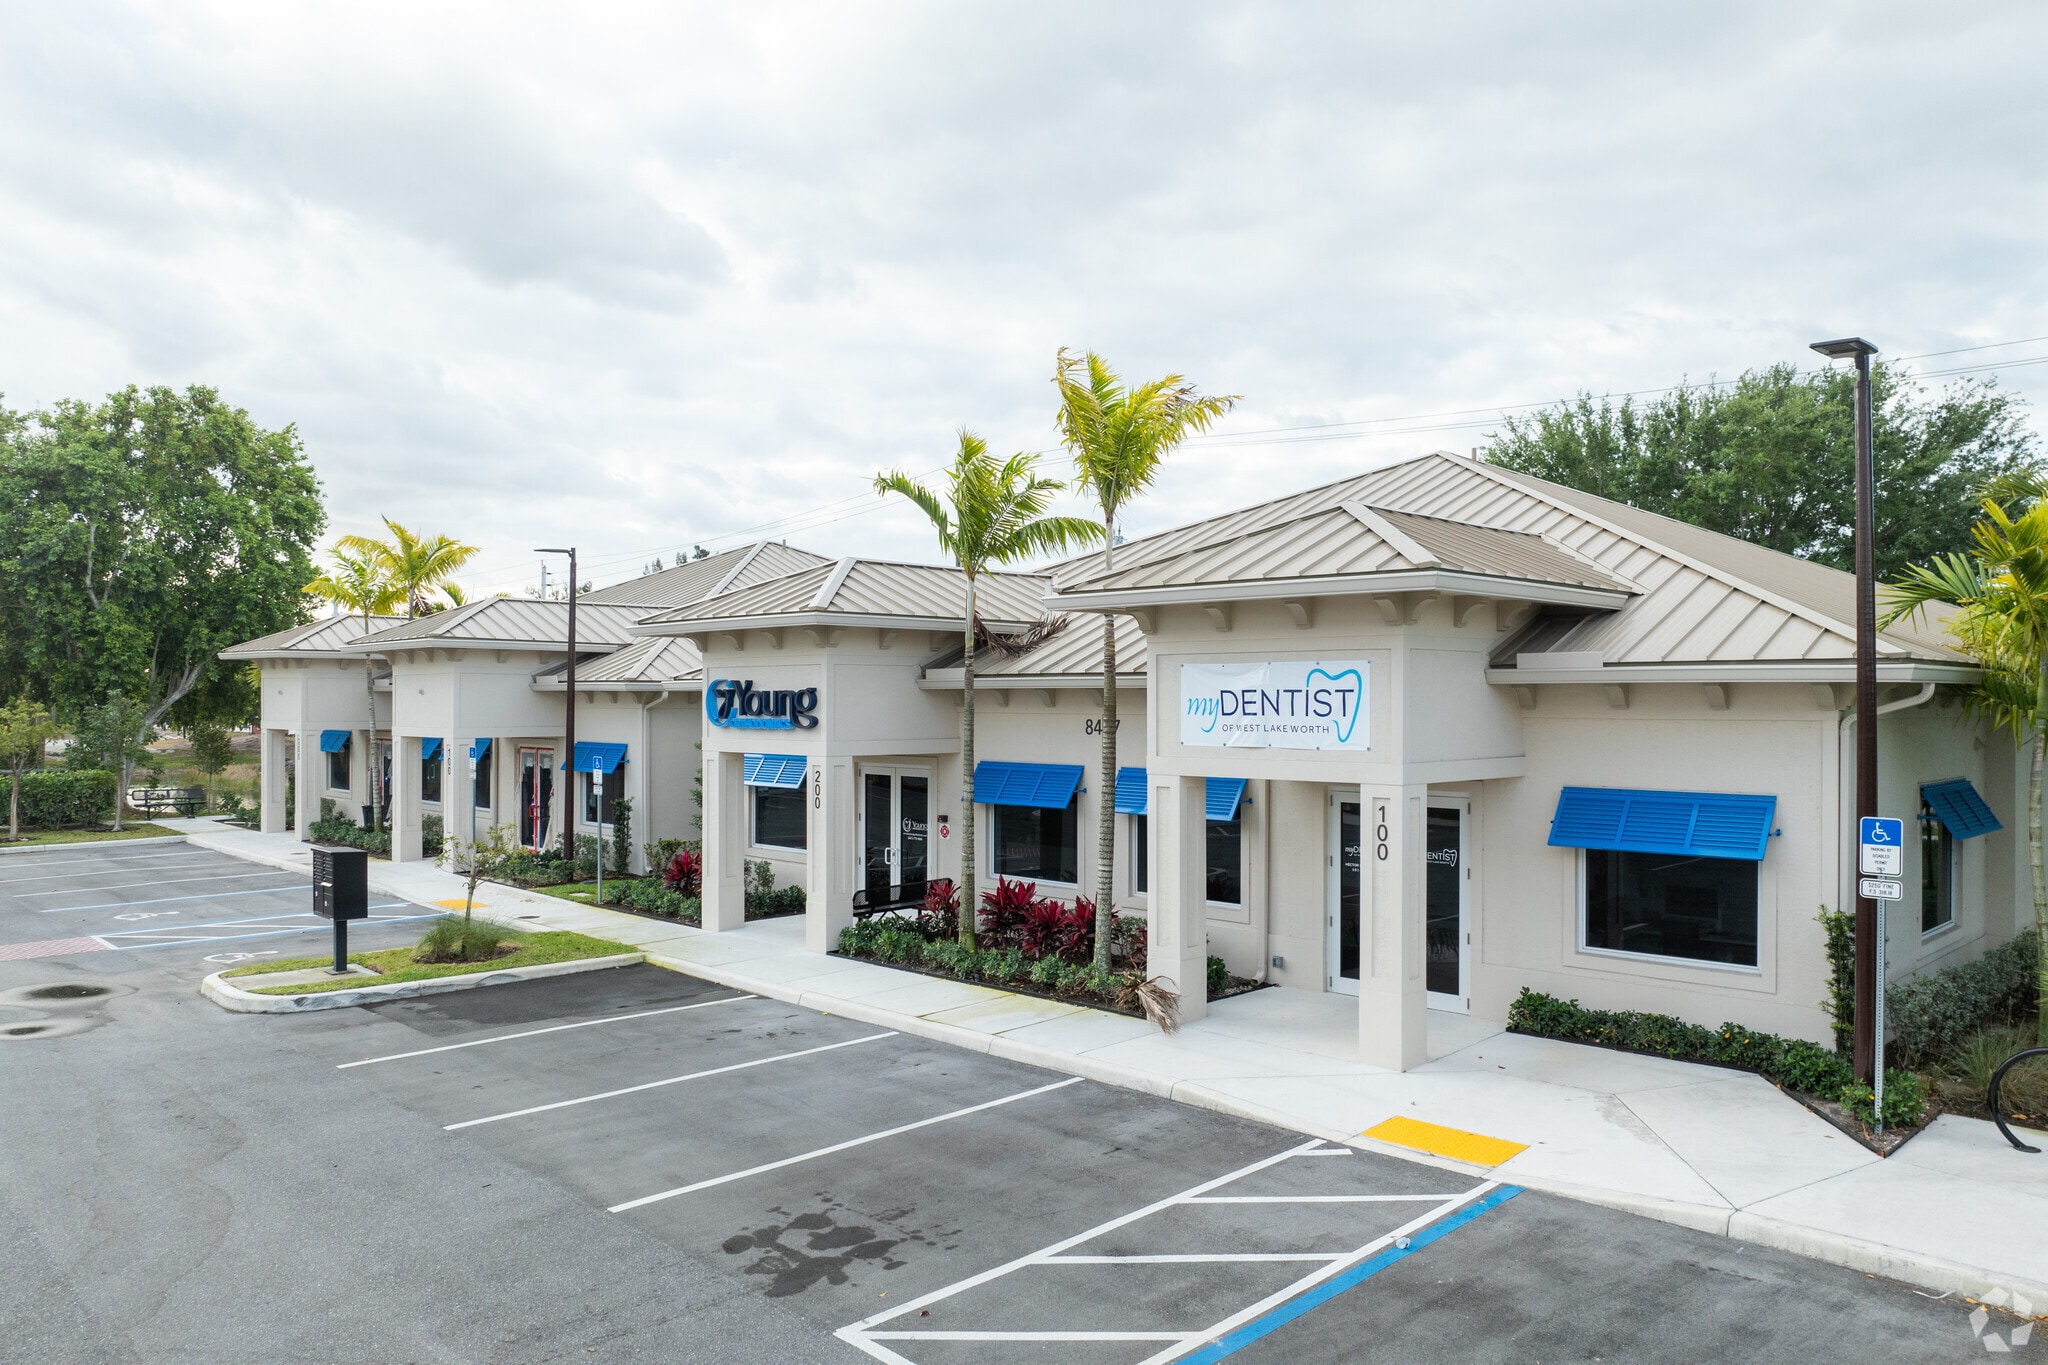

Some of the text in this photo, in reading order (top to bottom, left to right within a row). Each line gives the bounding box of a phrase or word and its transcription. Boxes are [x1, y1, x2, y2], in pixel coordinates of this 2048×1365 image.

[731, 680, 819, 729] Young
[1085, 718, 1120, 735] 847
[1222, 724, 1330, 734] OF WEST LAKE WORTH
[1377, 806, 1388, 861] 100
[1427, 852, 1455, 861] ENTIST
